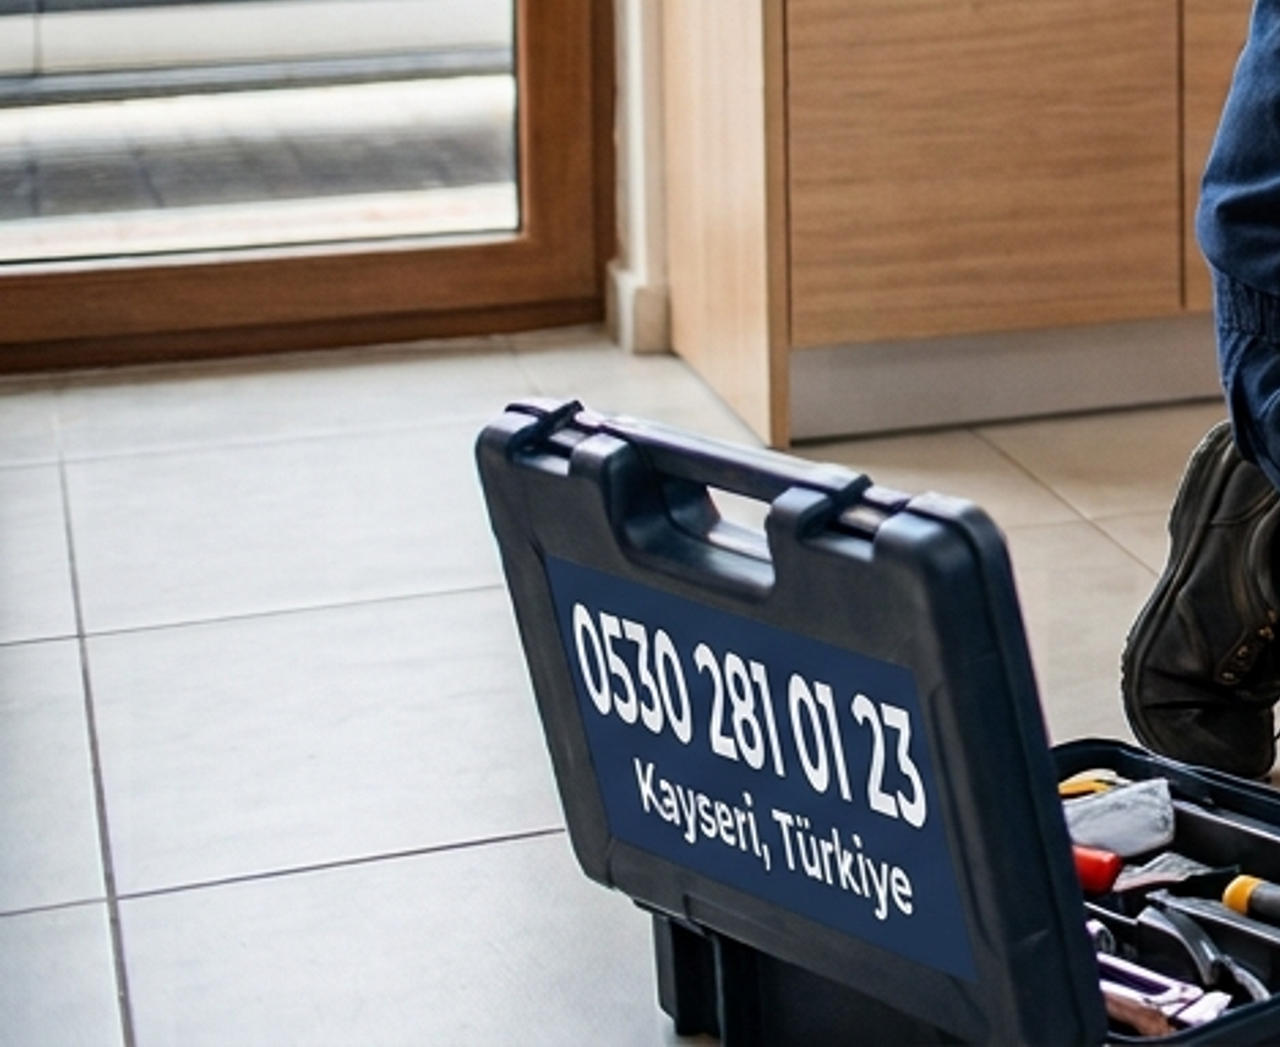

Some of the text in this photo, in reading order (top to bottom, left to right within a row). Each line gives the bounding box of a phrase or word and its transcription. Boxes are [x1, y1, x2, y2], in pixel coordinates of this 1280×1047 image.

[572, 602, 927, 828] 0530 281 01 23
[634, 758, 913, 921] Kayseri, Türkiye
